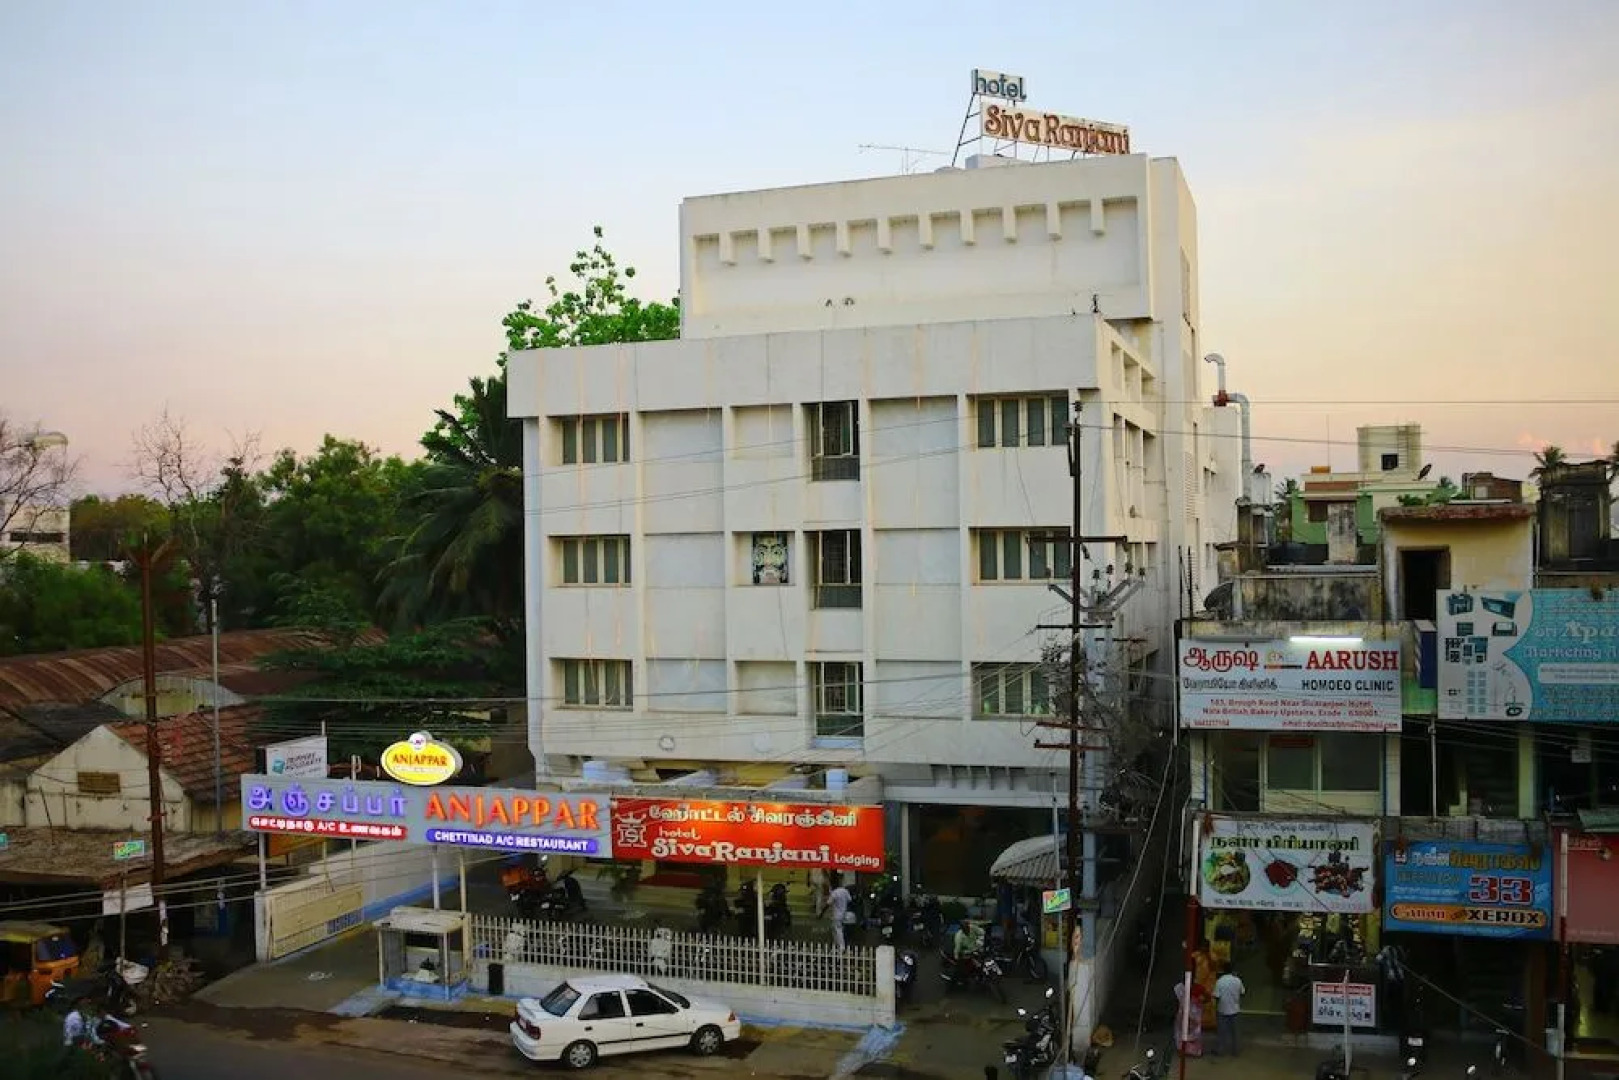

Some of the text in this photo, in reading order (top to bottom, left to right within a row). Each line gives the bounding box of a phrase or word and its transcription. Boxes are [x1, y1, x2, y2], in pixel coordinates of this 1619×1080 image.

[973, 69, 1027, 100] hotel
[1305, 650, 1399, 670] AARUSH
[1301, 679, 1394, 691] HOMOEO CLINIC
[1258, 699, 1279, 707] Road
[1281, 699, 1300, 707] Near
[1250, 708, 1279, 717] Bakery
[393, 753, 447, 767] ANJAPPAR
[249, 782, 408, 817] அஞ்சப்பர்
[424, 790, 600, 830] ANJAPPAR
[317, 821, 336, 832] A/C
[658, 826, 701, 840] hotel
[434, 831, 589, 852] CHETTINAD A/C RESTAURANT
[833, 853, 880, 868] Lodging
[1469, 874, 1533, 905] 33
[1468, 909, 1540, 925] XEROX
